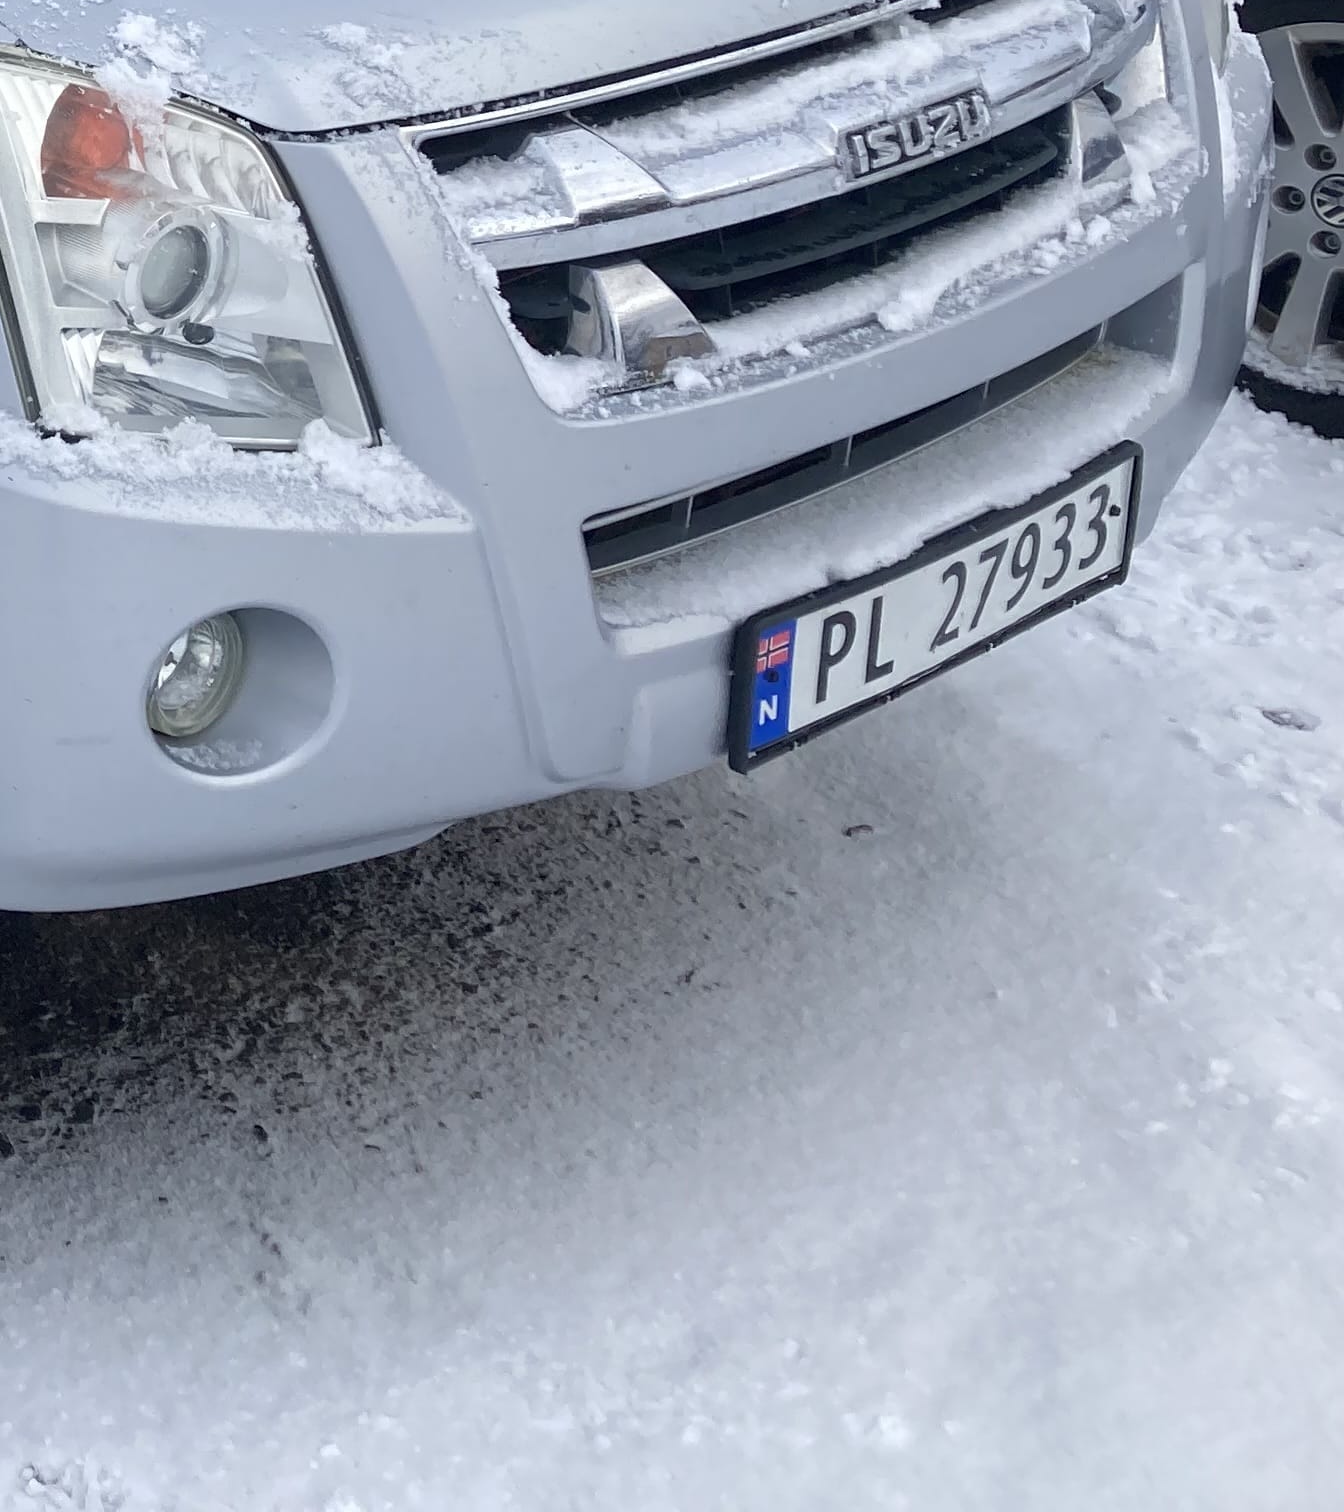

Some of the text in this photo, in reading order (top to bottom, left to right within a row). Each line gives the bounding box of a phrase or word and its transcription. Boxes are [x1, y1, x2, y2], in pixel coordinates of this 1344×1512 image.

[851, 94, 992, 174] ISUZU
[815, 483, 1111, 704] PL 27933
[758, 694, 778, 725] N
